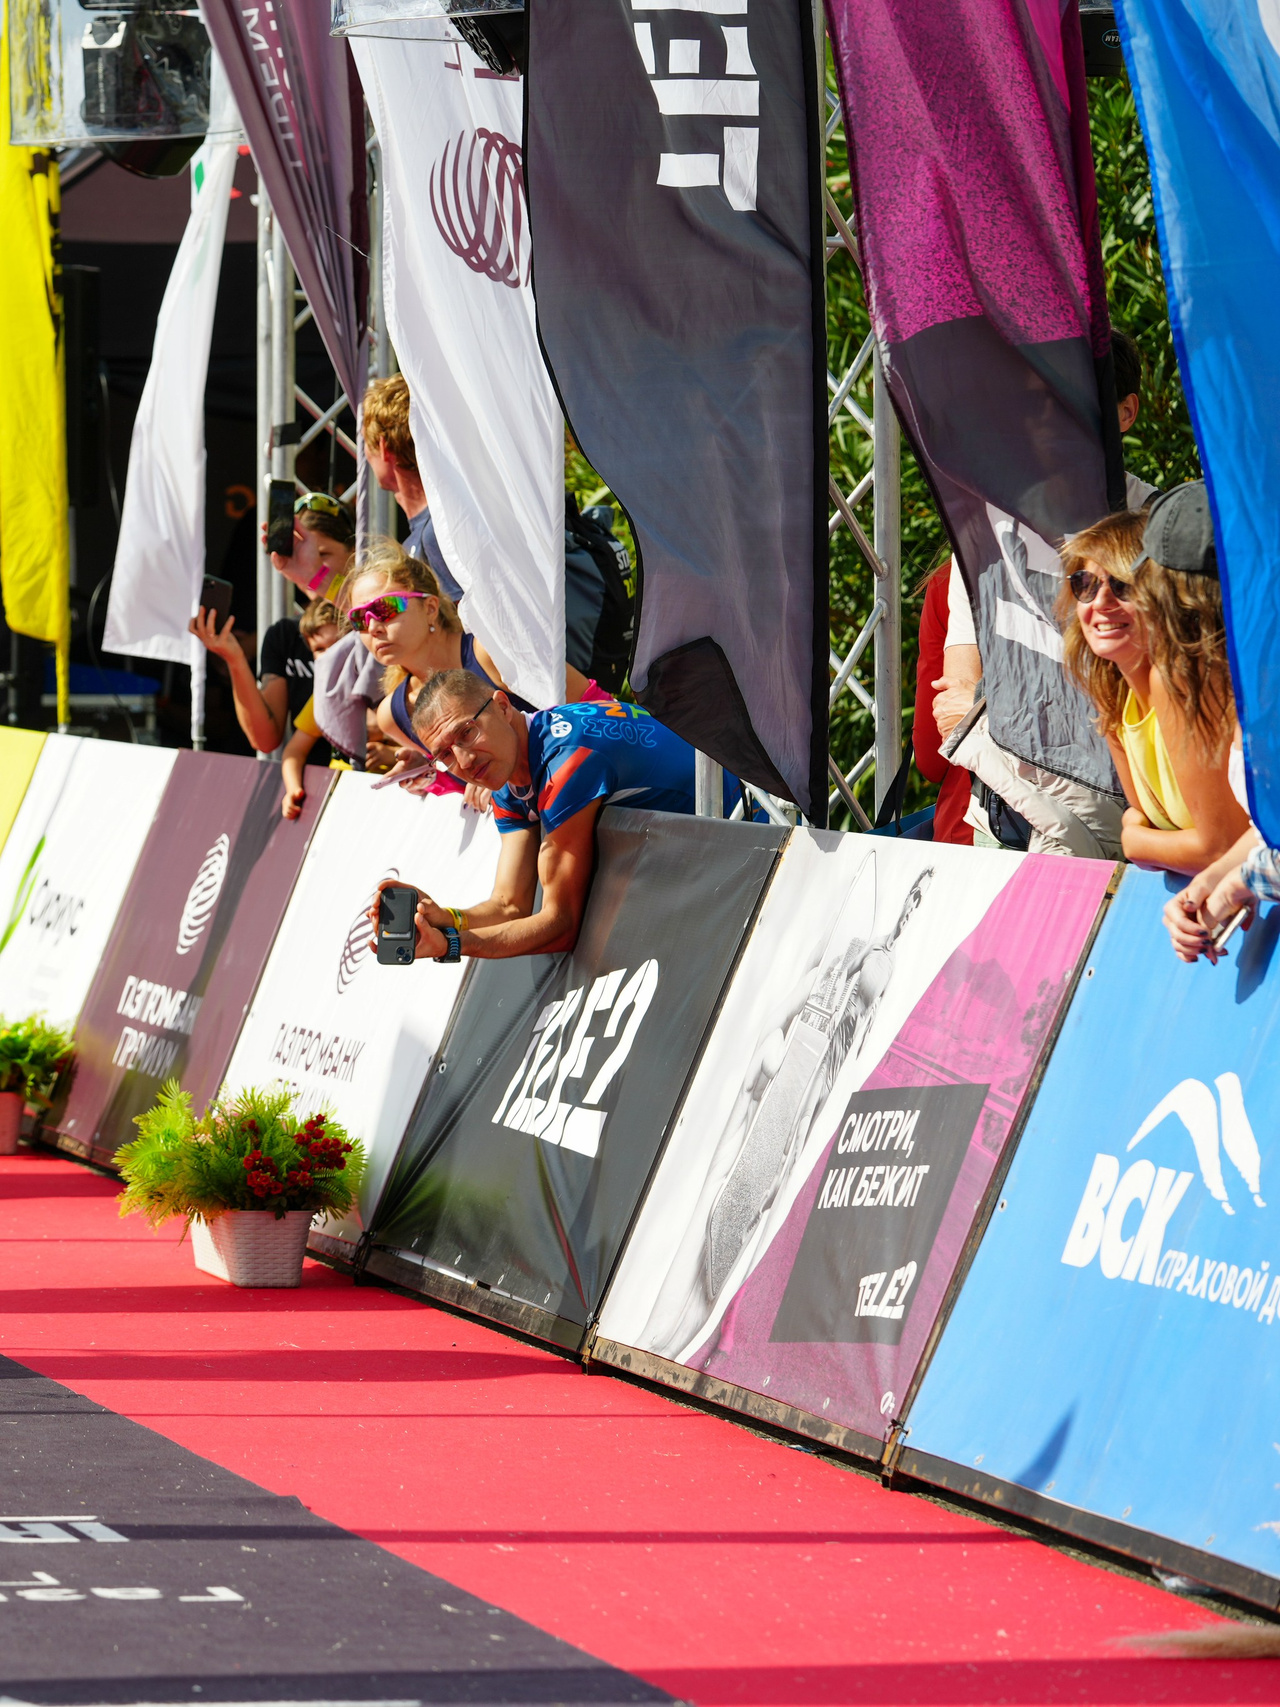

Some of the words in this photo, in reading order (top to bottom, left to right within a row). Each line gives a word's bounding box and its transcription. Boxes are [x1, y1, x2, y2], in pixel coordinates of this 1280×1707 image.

[581, 716, 657, 748] 2023
[269, 1023, 366, 1082] ГАЗПРОМБАНК
[491, 958, 658, 1158] TELE2
[837, 1109, 921, 1161] СМОТРИ,
[818, 1167, 855, 1209] КАК
[852, 1165, 930, 1207] БЕЖИТ
[1060, 1153, 1194, 1286] ВСК
[854, 1260, 917, 1319] TELE2
[1154, 1249, 1270, 1312] СТРАХОВОЙ
[1257, 1275, 1280, 1325] Д
